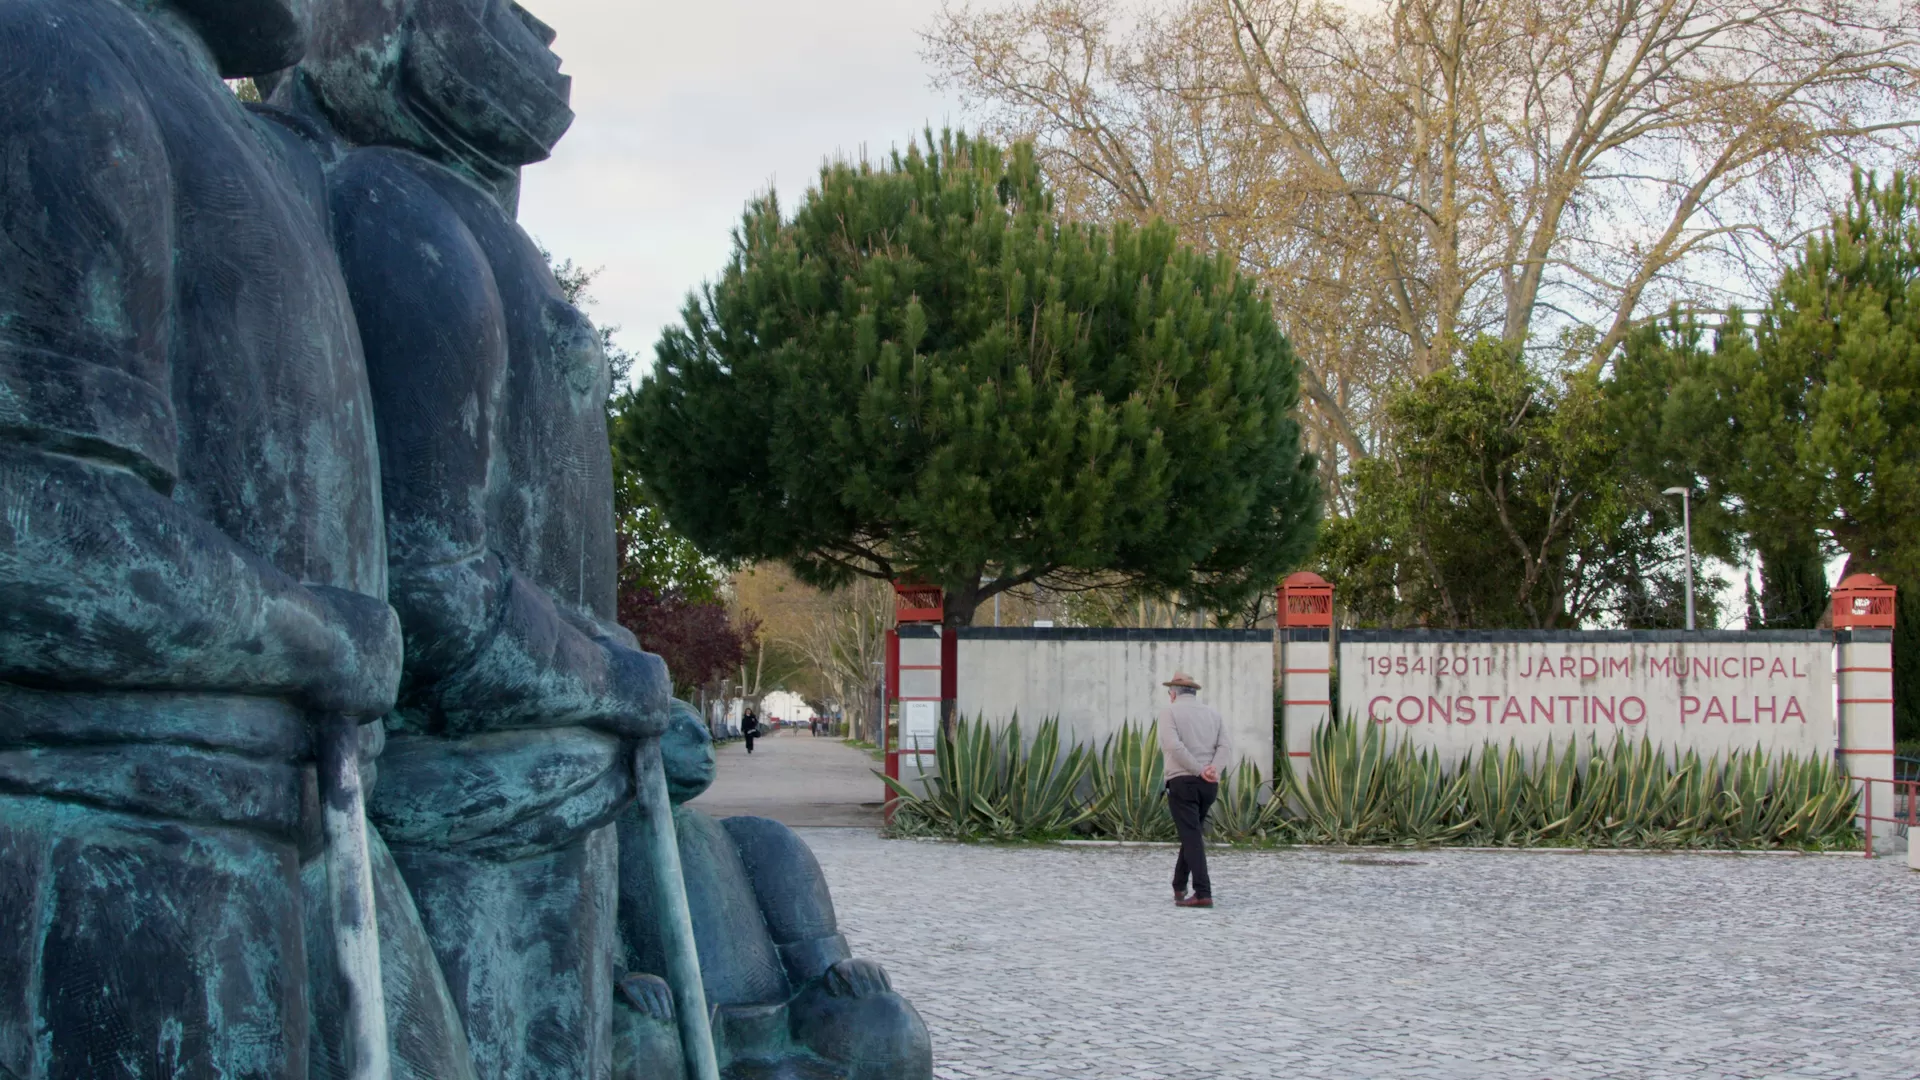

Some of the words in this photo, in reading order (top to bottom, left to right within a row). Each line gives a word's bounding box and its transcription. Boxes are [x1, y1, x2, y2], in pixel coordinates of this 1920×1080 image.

[1520, 657, 1629, 678] JARDIM
[1650, 657, 1806, 678] MUNICIPAL
[1368, 696, 1646, 725] CONSTANTINO
[1680, 696, 1806, 724] PALHA
